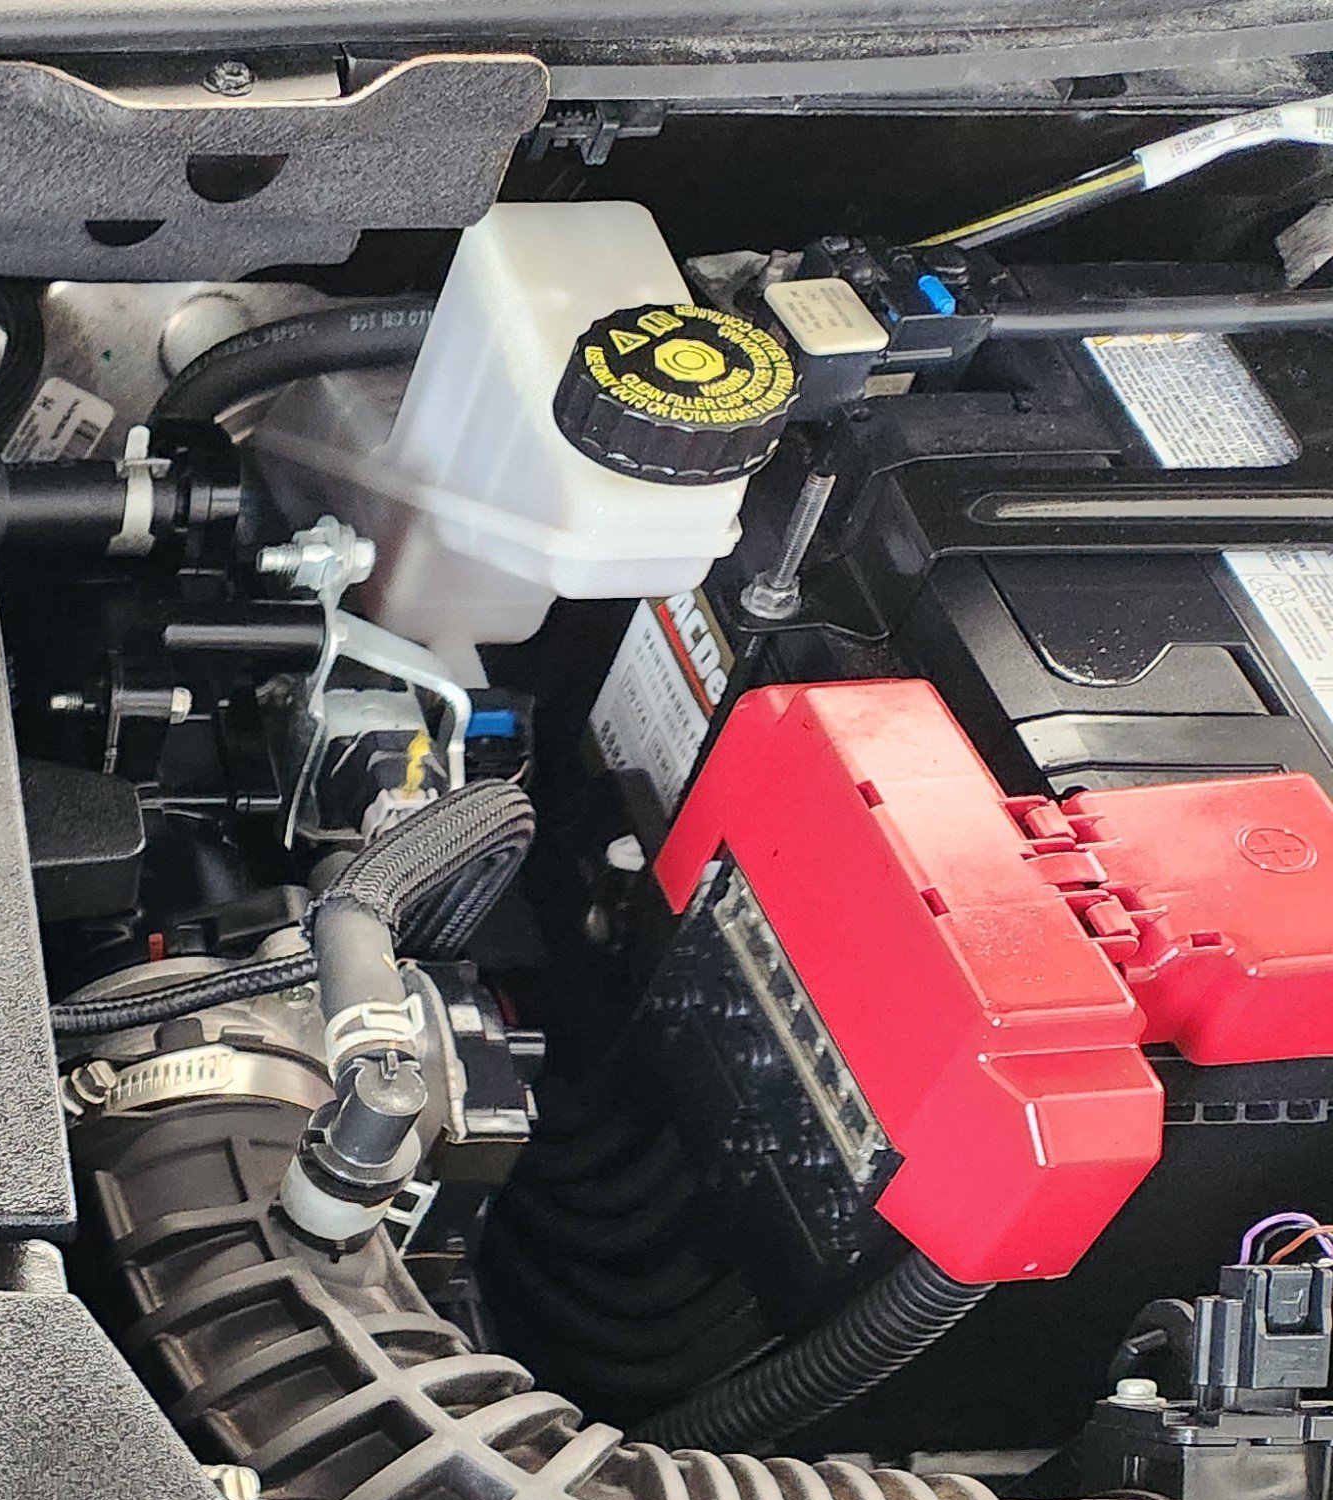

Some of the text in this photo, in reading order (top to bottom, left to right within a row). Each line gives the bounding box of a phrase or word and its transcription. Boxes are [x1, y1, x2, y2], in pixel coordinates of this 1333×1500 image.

[674, 305, 753, 333] CONTAINER
[621, 373, 666, 402] CLEAN
[665, 392, 717, 411] FILLER
[716, 393, 744, 409] CAP
[698, 367, 751, 397] WARNING
[610, 385, 650, 409] DOT3
[646, 401, 670, 418] OR
[670, 407, 709, 424] DOT4
[709, 404, 761, 424] BRAKE
[666, 590, 729, 706] ACDe
